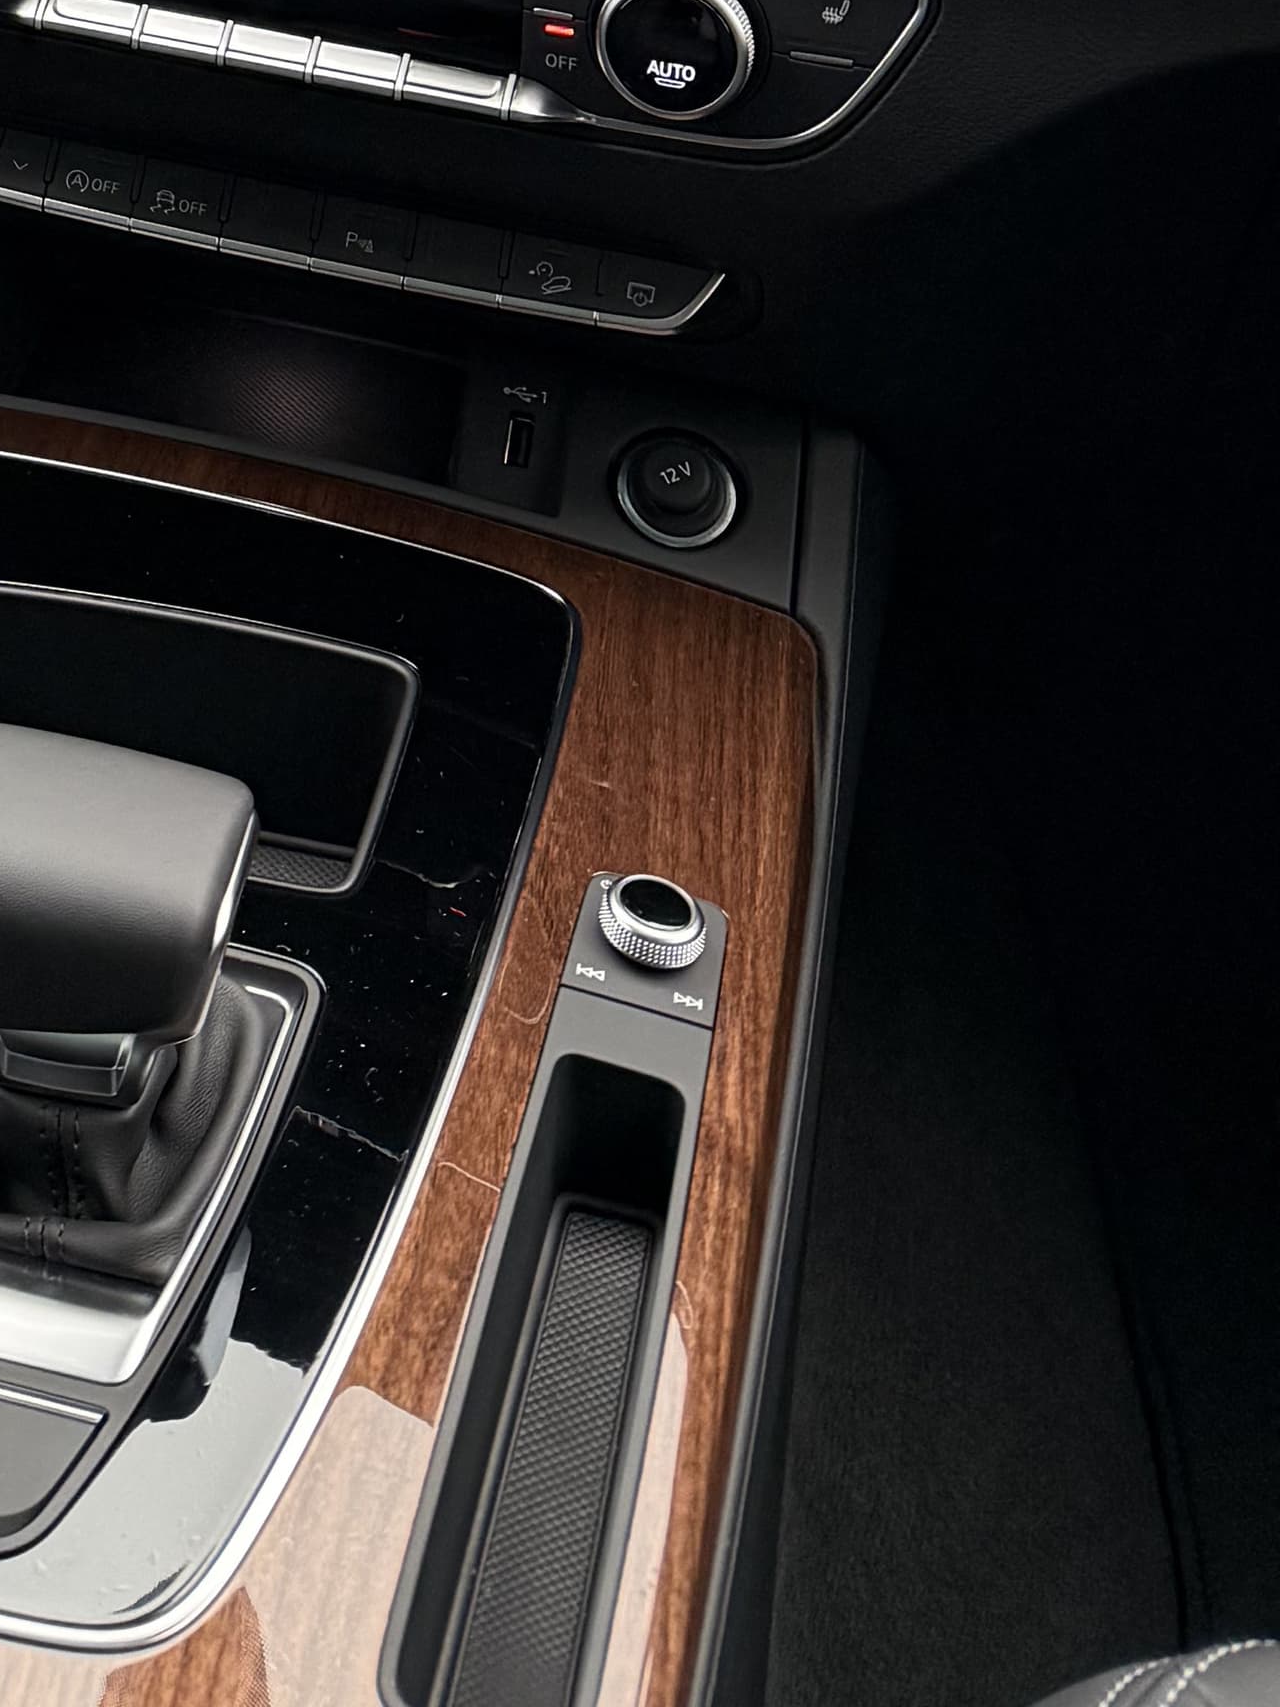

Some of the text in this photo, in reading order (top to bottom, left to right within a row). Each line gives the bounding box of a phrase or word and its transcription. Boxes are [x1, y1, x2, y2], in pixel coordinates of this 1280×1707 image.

[545, 53, 577, 72] OFF
[646, 59, 696, 82] AUTO
[91, 177, 121, 195] OFF
[178, 199, 209, 216] OFF
